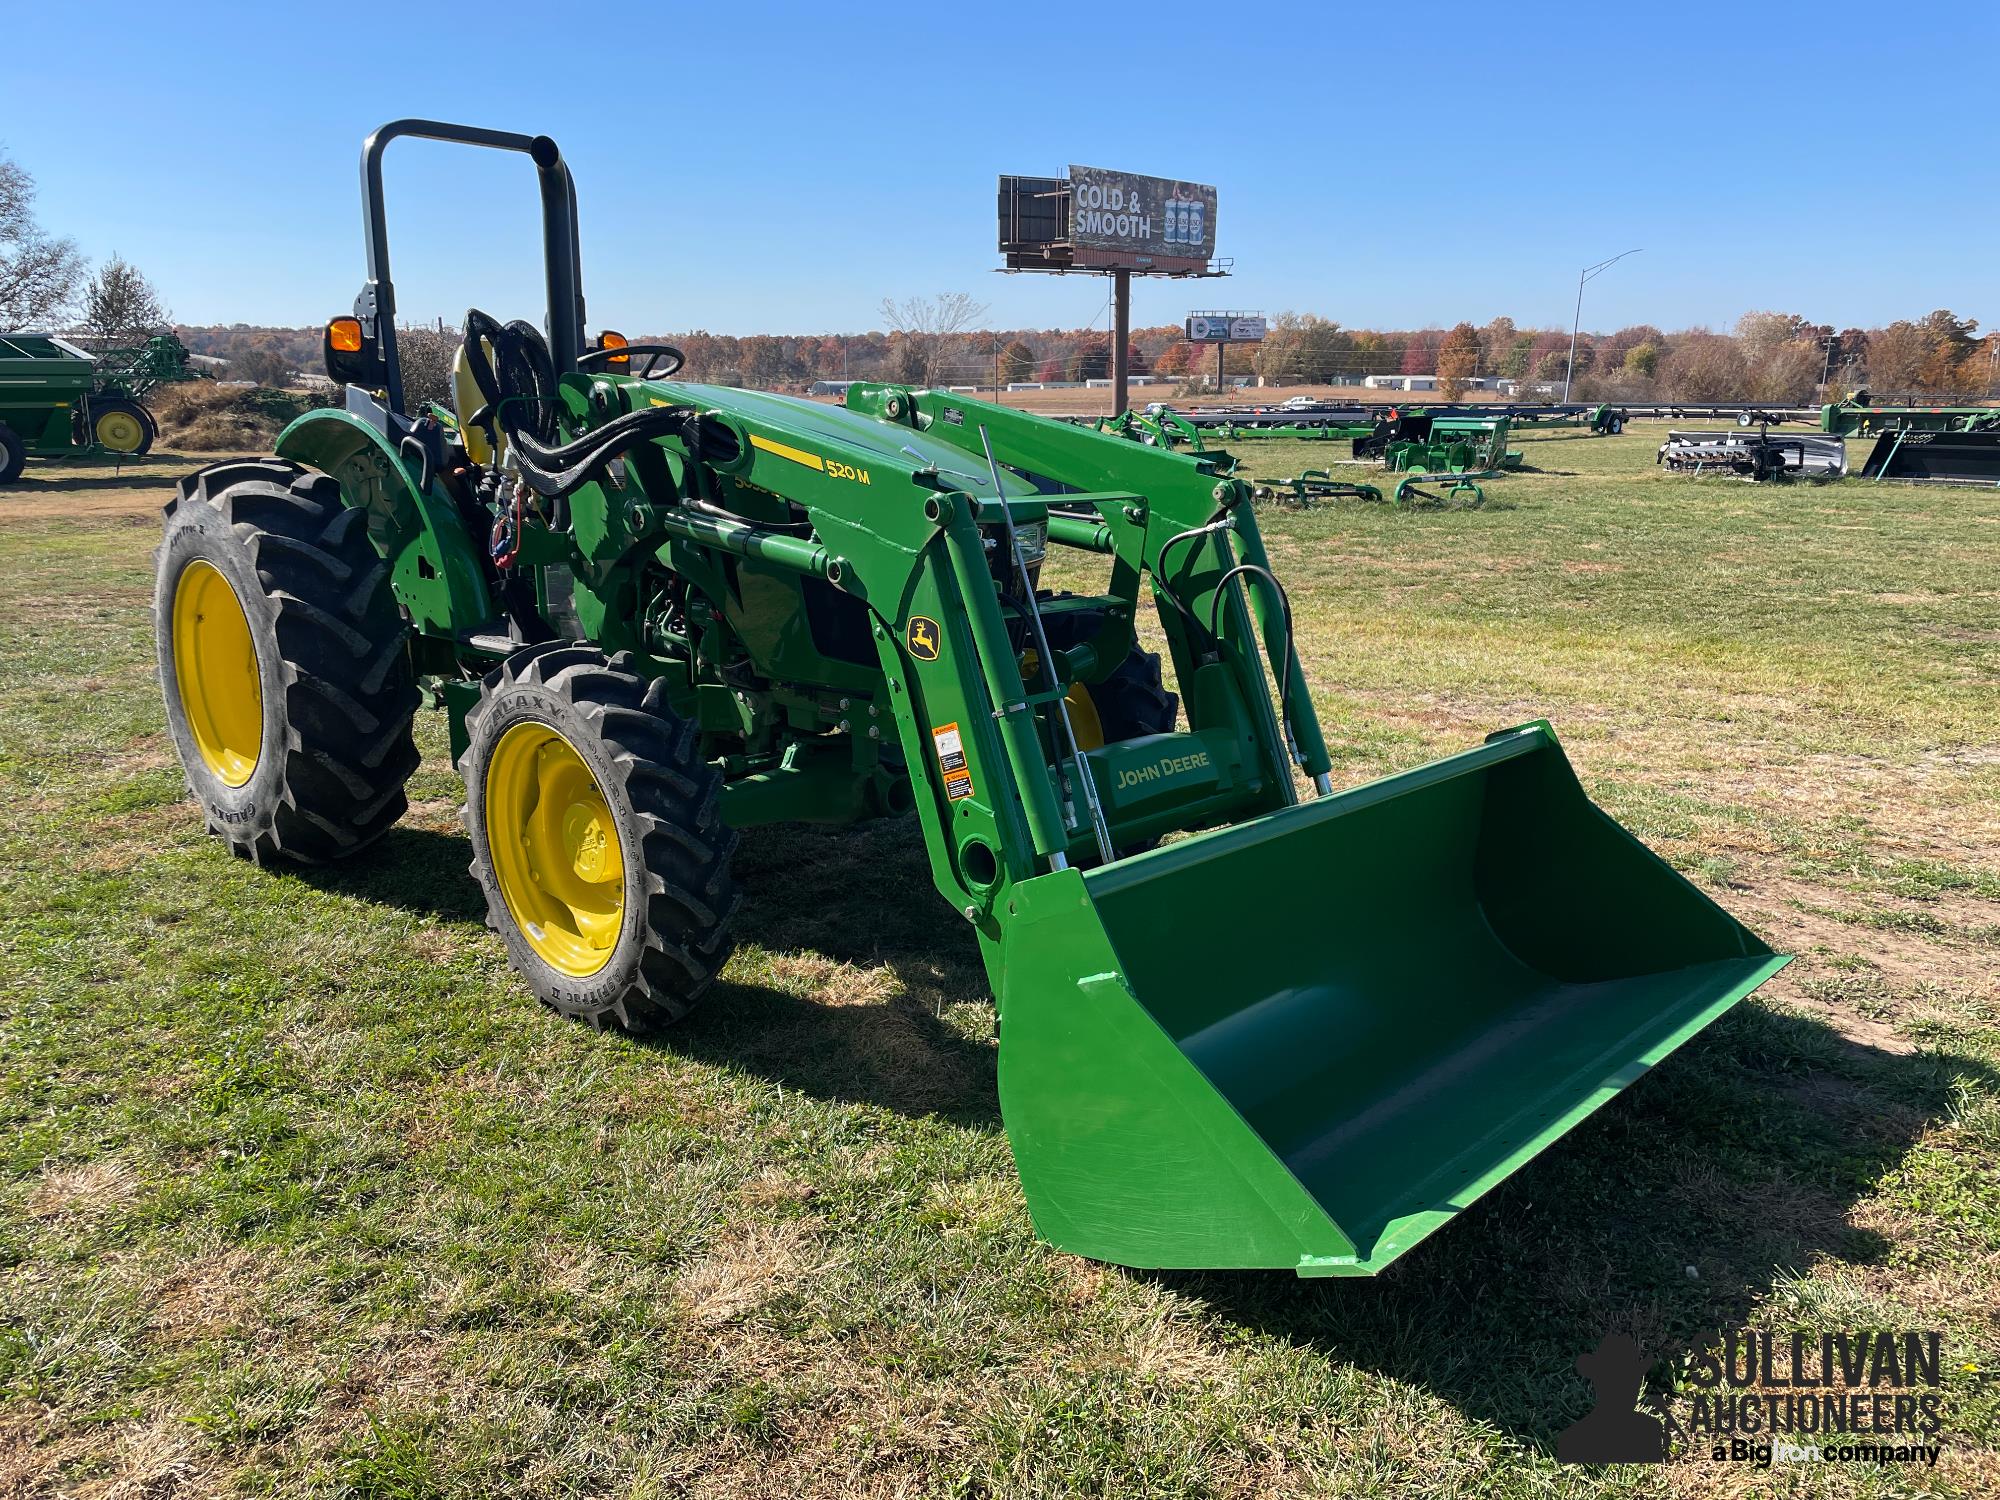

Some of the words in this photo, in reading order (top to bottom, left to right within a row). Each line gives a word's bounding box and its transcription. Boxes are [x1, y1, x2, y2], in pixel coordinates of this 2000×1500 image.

[1077, 184, 1124, 210] COLD
[1129, 191, 1141, 213] &
[1076, 210, 1151, 239] SMOOTH
[826, 459, 856, 481] 520
[857, 468, 872, 486] M
[483, 695, 564, 739] GALAXY
[1117, 764, 1161, 790] JOHN
[1160, 752, 1210, 776] DEERE
